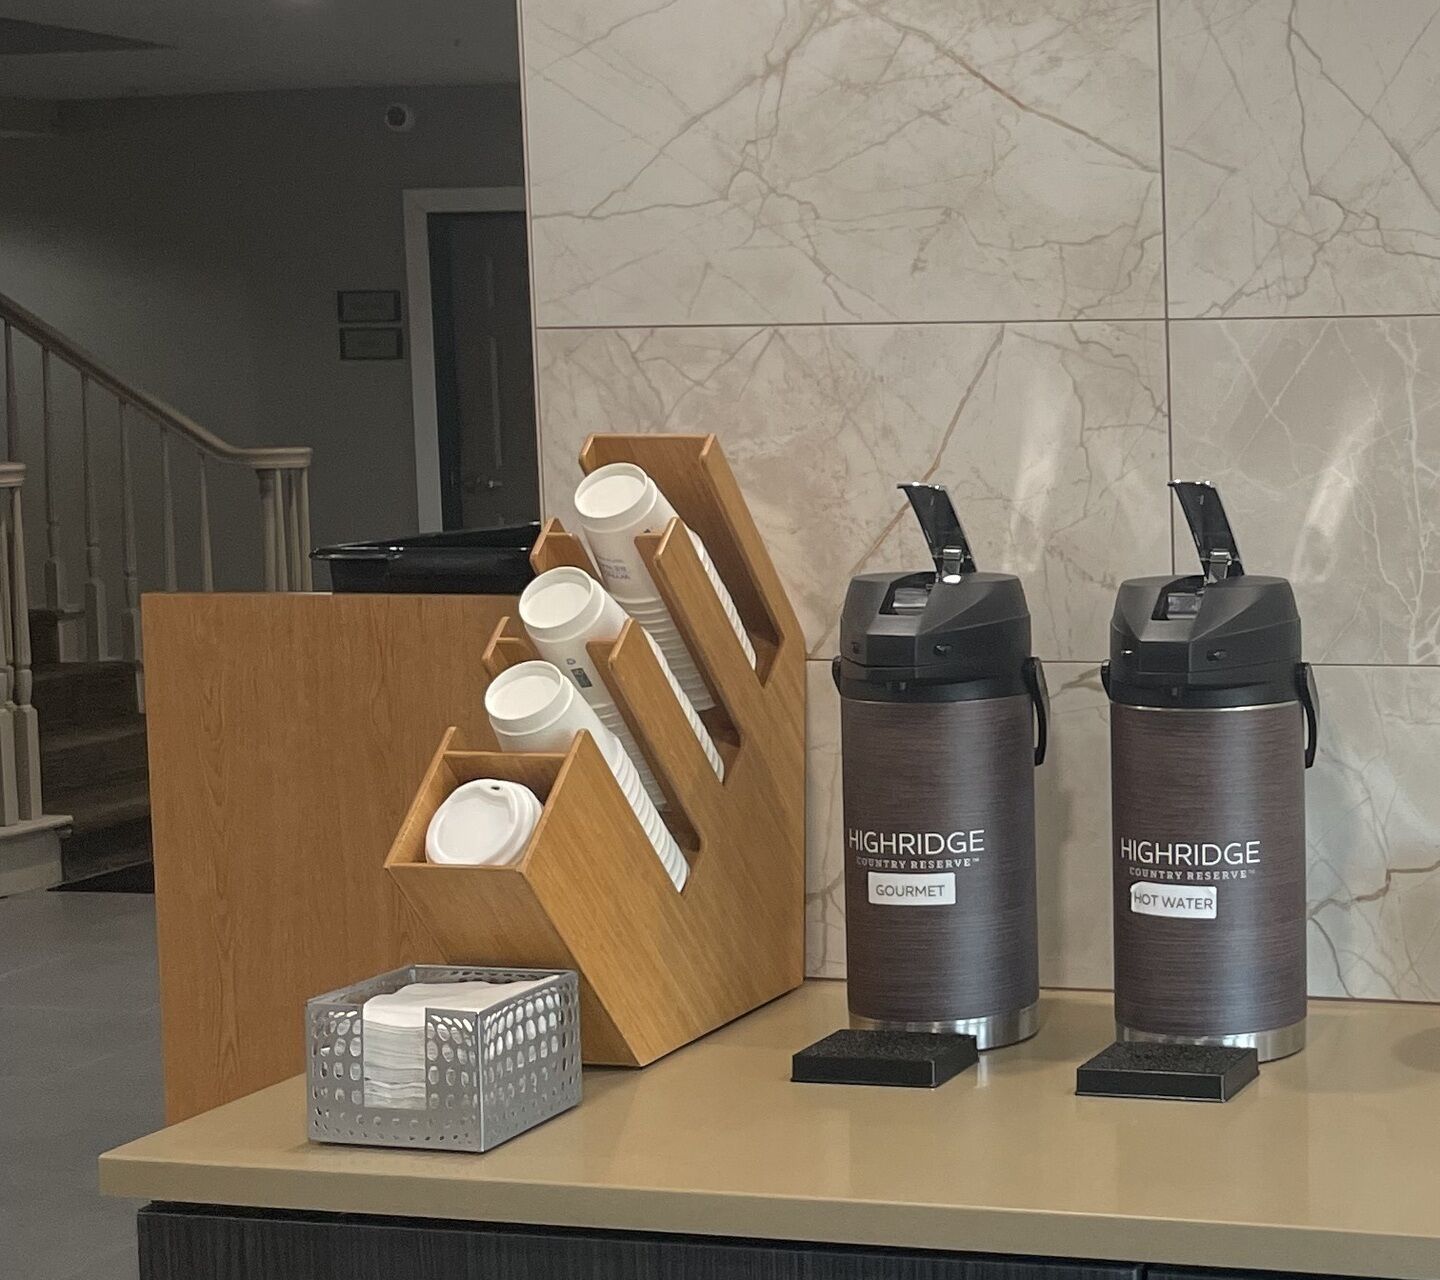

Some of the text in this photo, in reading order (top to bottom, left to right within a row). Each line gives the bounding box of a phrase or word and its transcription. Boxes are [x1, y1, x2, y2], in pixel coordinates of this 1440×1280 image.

[848, 827, 985, 855] HIGHRIDGE
[1120, 836, 1261, 866] HIGHRIDGE
[856, 856, 906, 869] COUNTRY
[1129, 866, 1183, 880] COUNTRY
[875, 884, 946, 897] GOURMET
[1133, 891, 1213, 910] HOT WATER
